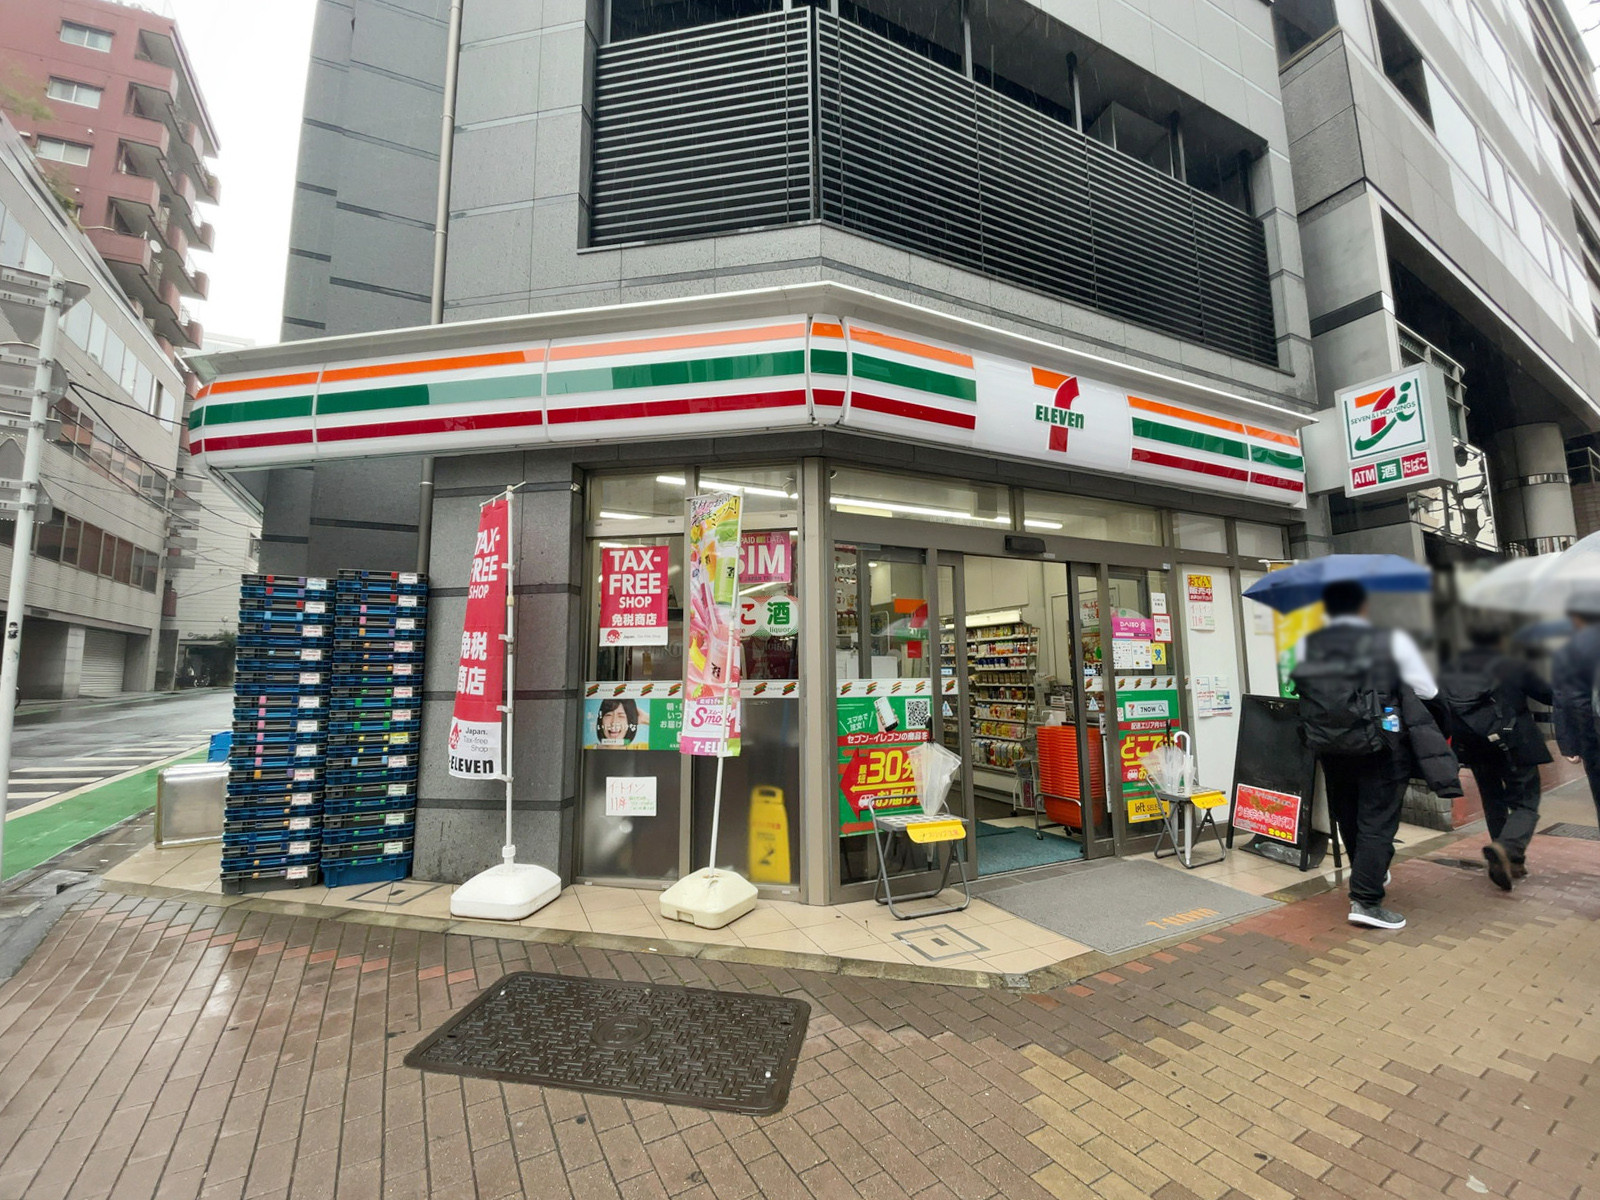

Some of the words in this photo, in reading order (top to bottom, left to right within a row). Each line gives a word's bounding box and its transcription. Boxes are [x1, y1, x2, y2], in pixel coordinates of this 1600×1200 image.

[1350, 414, 1371, 425] SEVEN
[1380, 401, 1416, 416] HOLDINGS
[1381, 463, 1397, 479] 酒
[1402, 457, 1428, 474] たばこ
[1354, 468, 1376, 485] ATM
[474, 526, 501, 556] TAX-
[740, 536, 756, 544] PAID
[609, 549, 662, 572] TAX-
[609, 572, 662, 595] FREE
[468, 584, 490, 599] SHOP
[618, 596, 653, 609] SHOP
[611, 612, 657, 627] 免税商店
[741, 603, 757, 625] こ
[767, 601, 791, 625] 酒
[769, 626, 792, 635] liquor
[667, 712, 682, 720] いつ
[465, 727, 489, 736] Japan.
[470, 744, 489, 753] Shop
[1267, 827, 1293, 841] 200円
